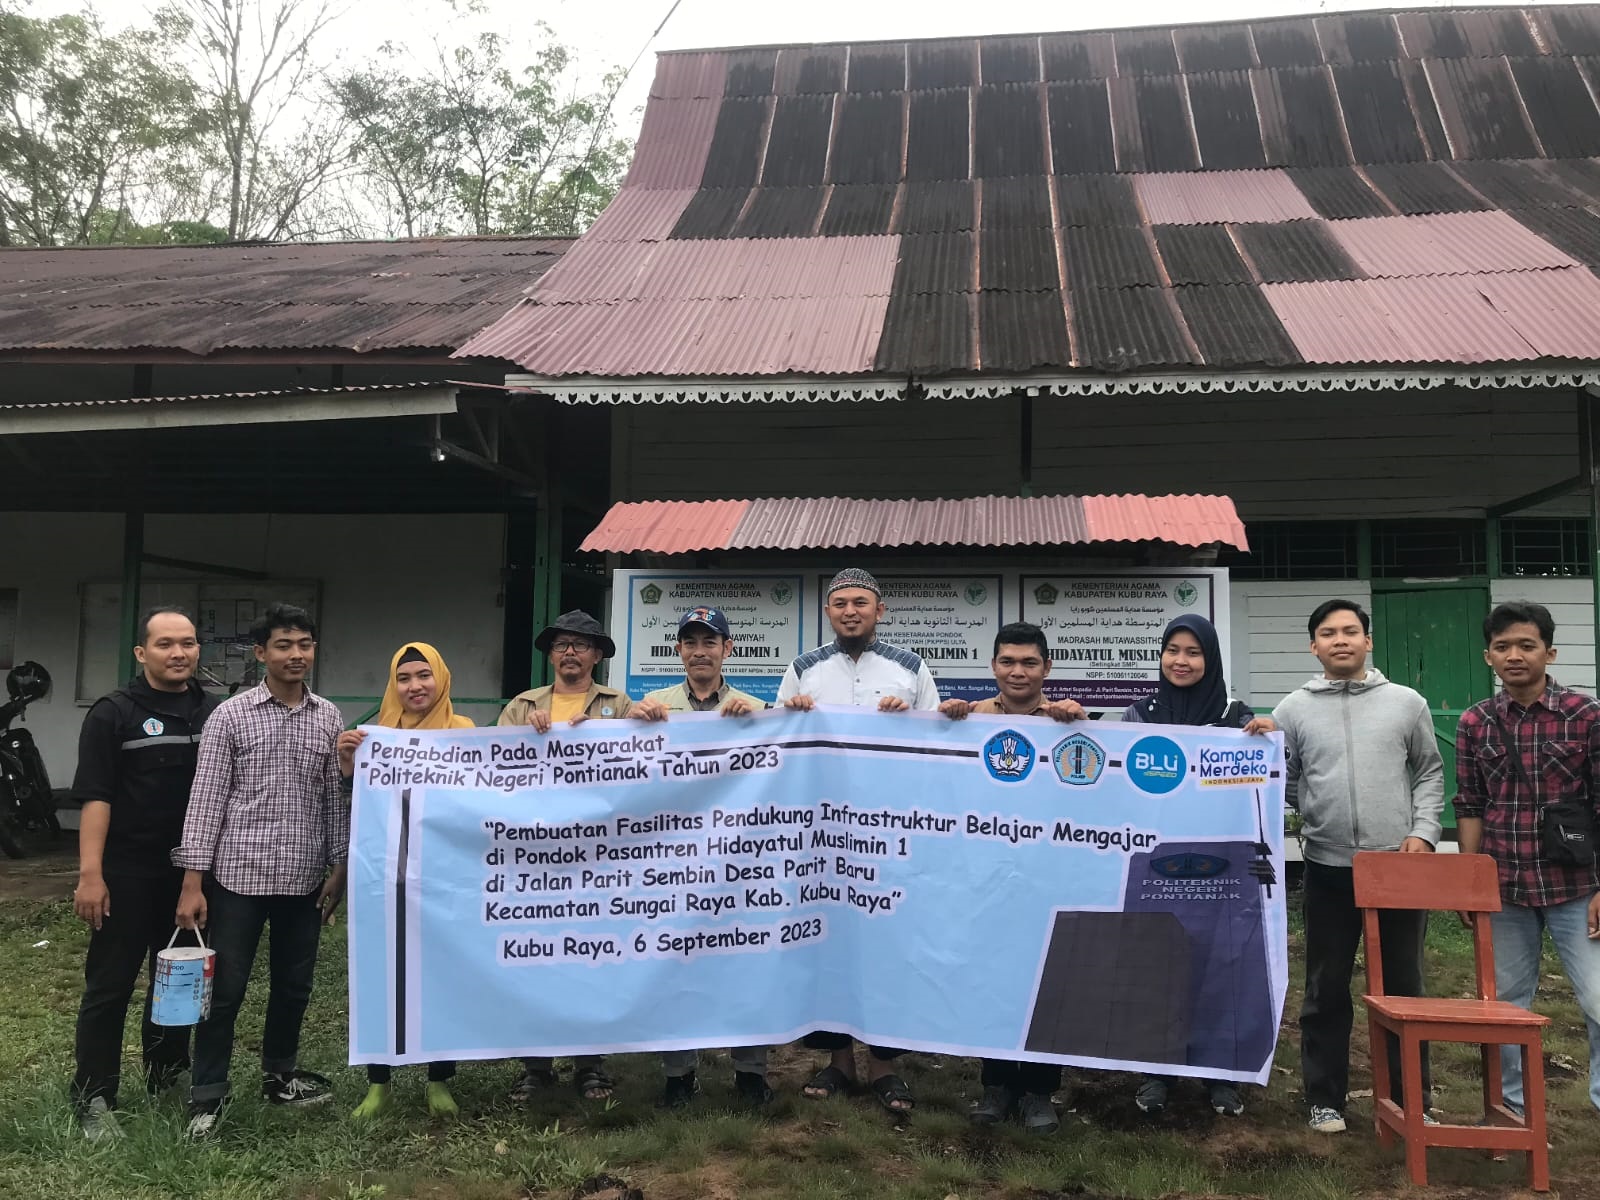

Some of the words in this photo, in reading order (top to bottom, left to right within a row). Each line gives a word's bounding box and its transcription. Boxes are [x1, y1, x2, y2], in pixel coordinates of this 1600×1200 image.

[669, 590, 714, 598] KABUPATEN
[717, 590, 740, 598] KUBU
[741, 590, 761, 598] RAYA
[880, 590, 910, 598] UPATEN
[912, 590, 935, 598] KUBU
[937, 590, 958, 598] RAYA
[1064, 590, 1116, 598] KABUPATEN
[728, 646, 771, 658] USLIMIN
[773, 646, 780, 658] 1
[973, 648, 978, 660] 1
[1047, 649, 1115, 661] HIDAYATUL
[371, 741, 482, 764] Pengabdian
[491, 743, 537, 763] Pada
[547, 734, 665, 765] Masyarakat
[1200, 748, 1264, 765] Kampus
[368, 766, 465, 787] Politeknik
[475, 768, 543, 792] Negeri
[553, 763, 648, 784] Pontianak
[658, 756, 720, 777] Tahun
[728, 750, 780, 774] 2023
[1200, 762, 1267, 777] Merdeka
[485, 821, 608, 841] “Pembuatan
[617, 813, 703, 836] Fasilitas
[713, 806, 815, 829] Pendukung
[820, 803, 957, 833] Infrastruktur
[967, 814, 1043, 843] Belajar
[1052, 822, 1157, 851] Mengajar
[486, 848, 505, 866] di
[514, 846, 586, 865] Pondok
[596, 840, 698, 861] Pasantren
[706, 832, 804, 858] Hidayatul
[811, 832, 887, 856] Muslimin
[897, 837, 907, 856] 1
[486, 875, 505, 893] di
[515, 872, 573, 893] Jalan
[582, 868, 633, 889] Parit
[642, 865, 715, 887] Sembin
[725, 861, 775, 882] Desa
[783, 856, 827, 878] Parit
[836, 861, 875, 882] Baru
[485, 900, 600, 921] Kecamatan
[609, 895, 677, 921] Sungai
[686, 892, 736, 916] Raya
[745, 888, 791, 909] Kab.
[799, 883, 840, 903] Kubu
[847, 888, 902, 914] Raya”
[503, 938, 554, 959] Kubu
[563, 936, 622, 960] Raya,
[634, 933, 647, 953] 6
[656, 927, 771, 957] September
[780, 919, 823, 944] 2023
